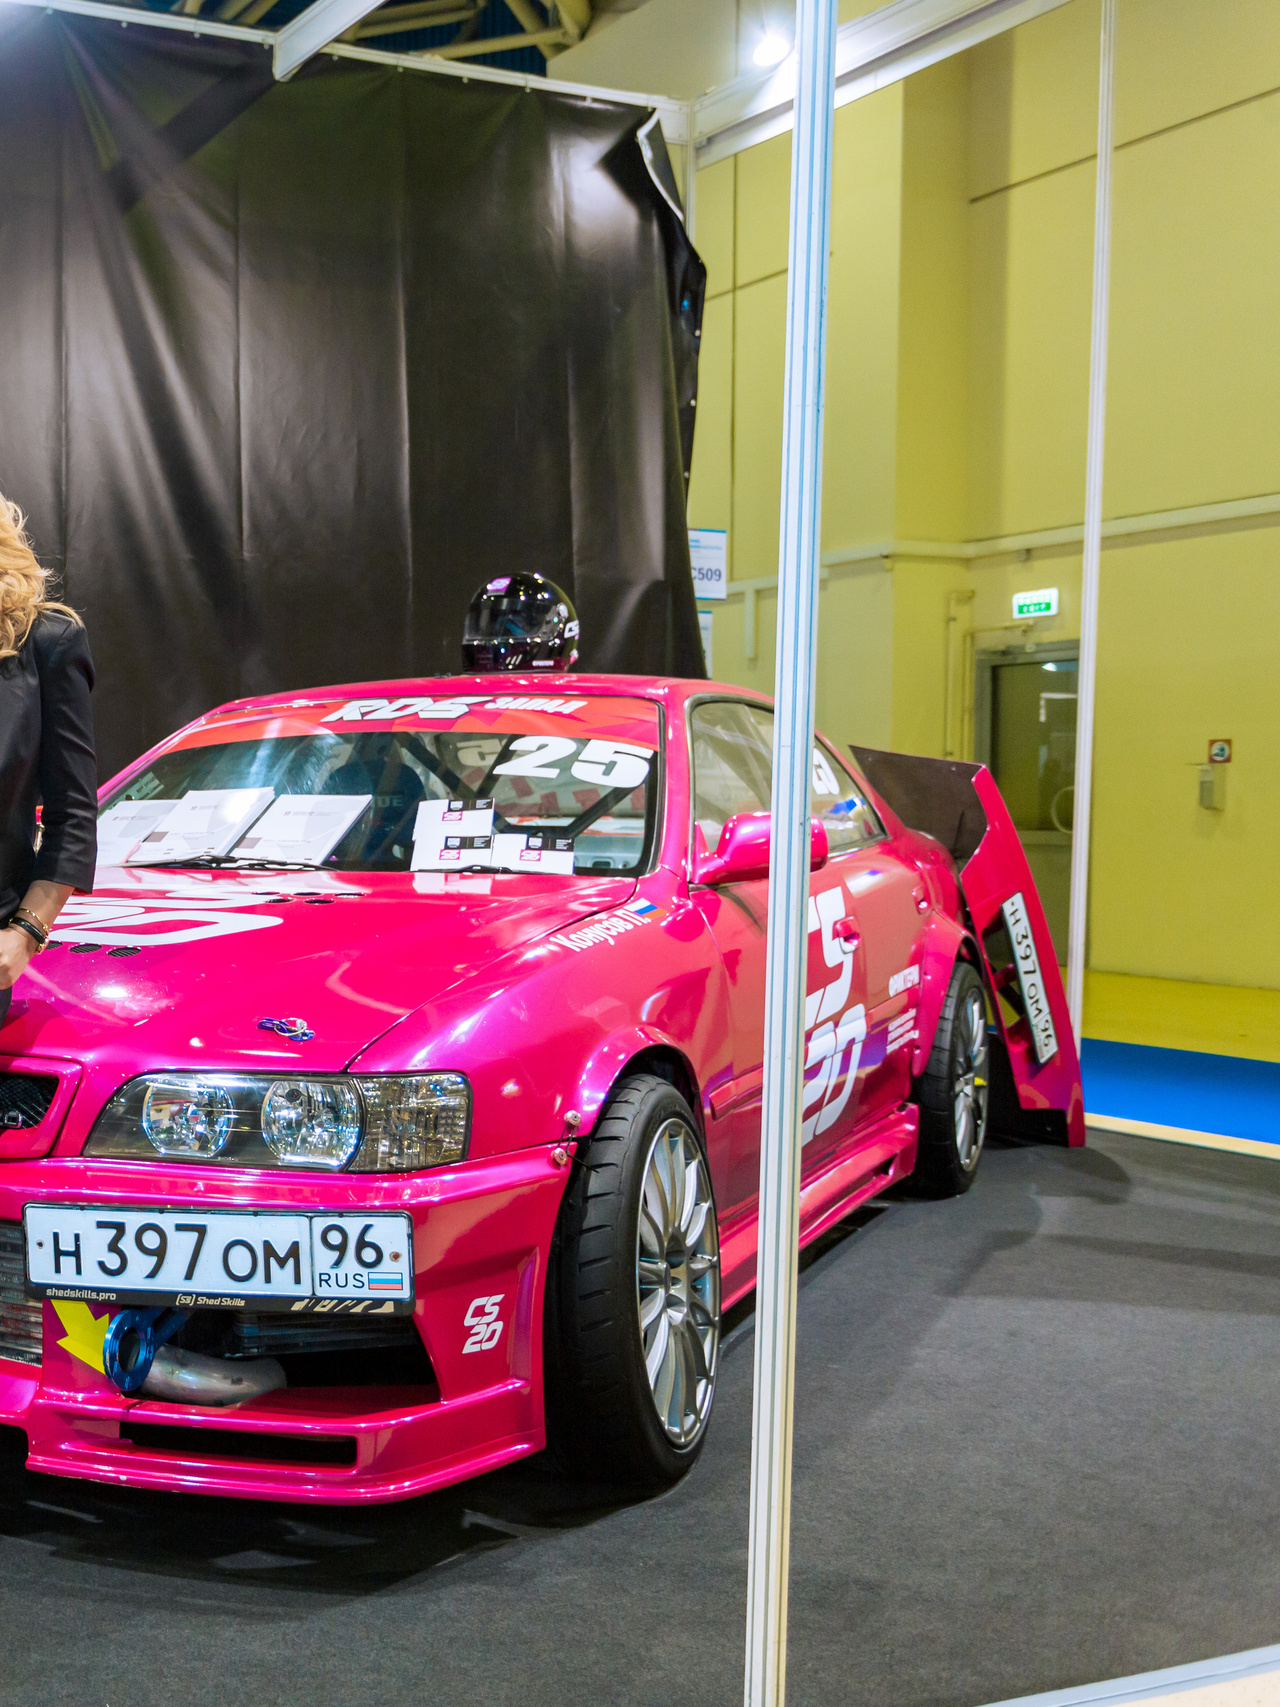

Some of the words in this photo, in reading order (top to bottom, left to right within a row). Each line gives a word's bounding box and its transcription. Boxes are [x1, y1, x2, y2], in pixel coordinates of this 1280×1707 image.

[320, 696, 493, 722] RDS
[484, 696, 588, 715] ЗАПАД
[492, 735, 654, 789] 25
[549, 917, 634, 952] Конусов
[1039, 1018, 1053, 1048] 96
[320, 1223, 385, 1270] 96
[45, 1287, 117, 1302] shedskills.pro
[319, 1272, 366, 1289] RUS
[197, 1296, 221, 1306] Shed
[221, 1297, 247, 1307] Skills
[463, 1293, 506, 1327] CS
[461, 1320, 504, 1355] 20
